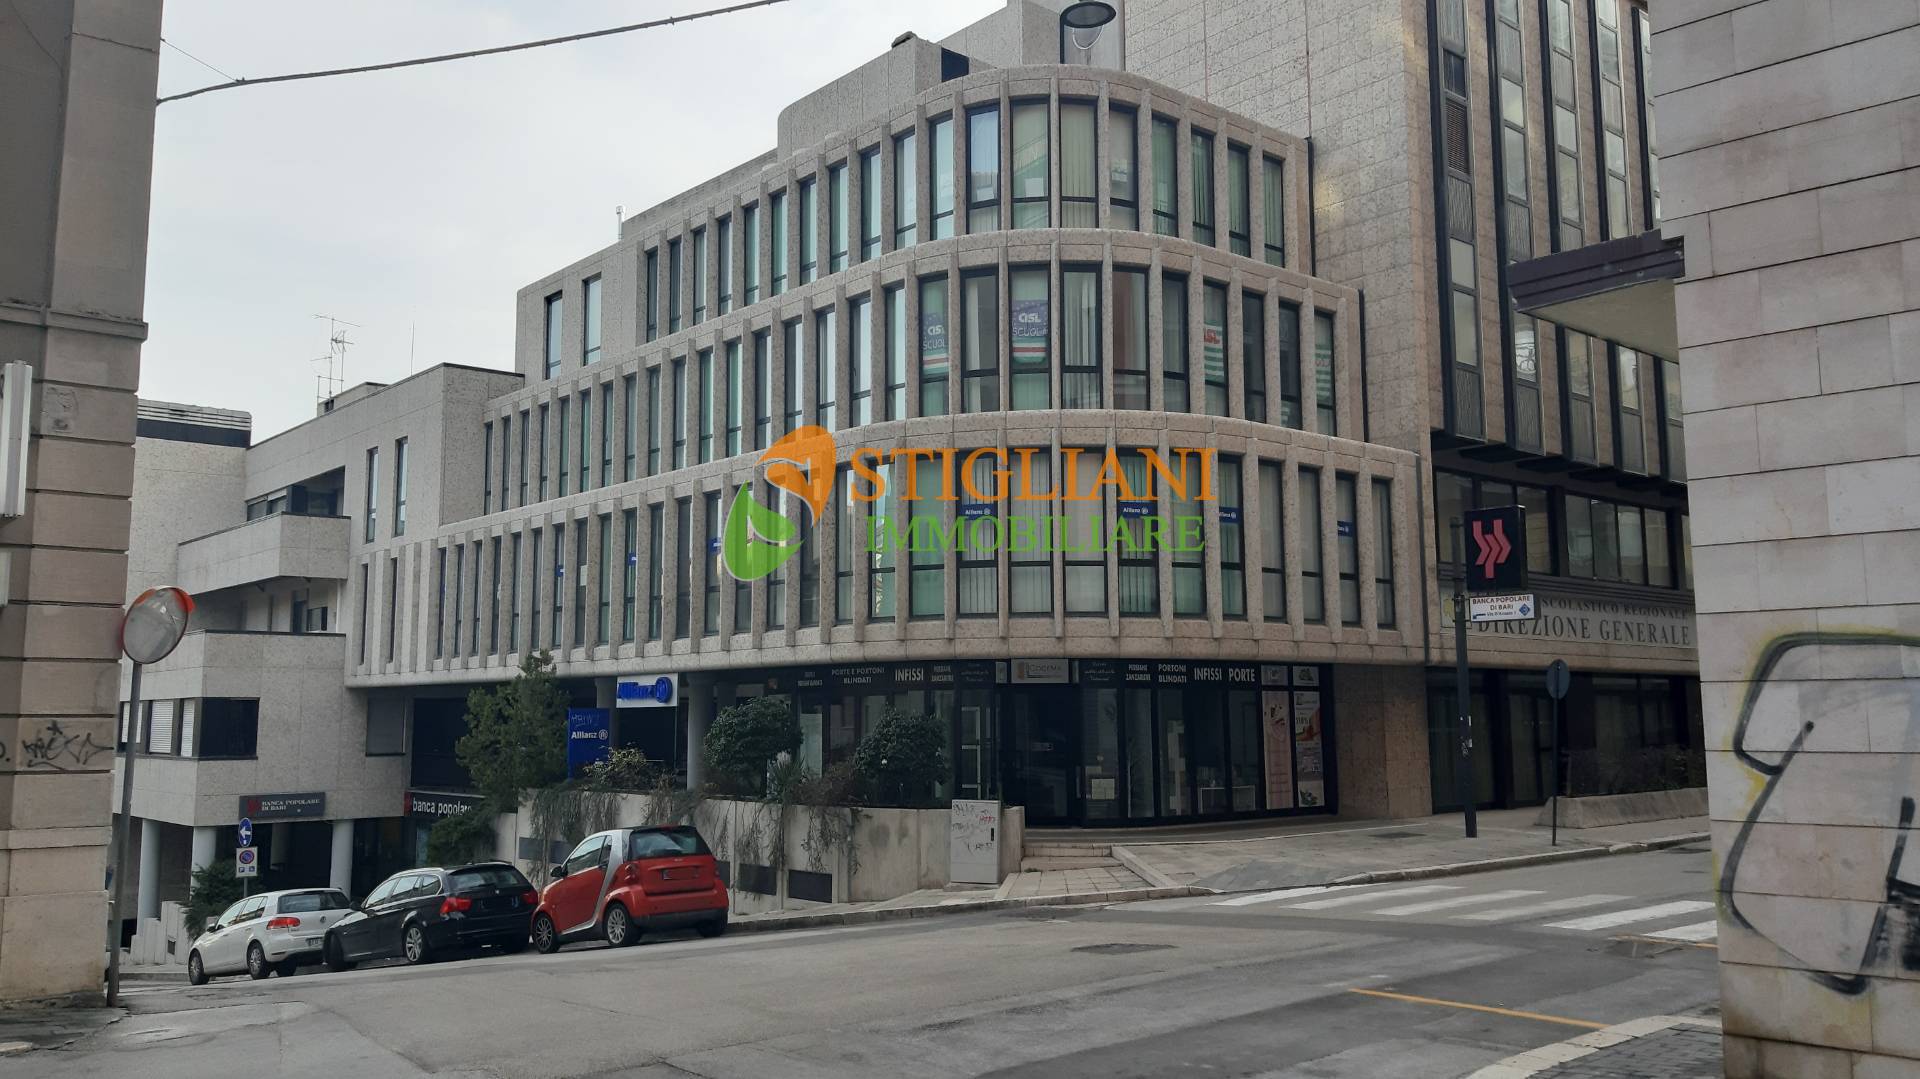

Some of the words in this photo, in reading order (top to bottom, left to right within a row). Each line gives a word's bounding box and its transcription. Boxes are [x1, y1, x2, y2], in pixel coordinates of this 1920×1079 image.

[1018, 313, 1041, 323] CISL
[1012, 327, 1049, 337] SCUOLA
[1472, 597, 1495, 605] BANCA
[1496, 595, 1531, 604] POPOLARE
[1541, 597, 1620, 614] SCOLASTICO
[1624, 601, 1689, 620] REGIONALE
[1478, 613, 1591, 640] DIREZIONE
[1600, 618, 1690, 646] GENERALE
[1158, 663, 1187, 673] PORTONI
[894, 667, 924, 682] INFISSI
[1158, 673, 1187, 683] BLINDATI
[1194, 667, 1223, 682] INFISSI
[1228, 667, 1256, 682] PORTE
[843, 676, 873, 685] BLINDATI
[571, 730, 598, 739] Allianz
[285, 798, 321, 806] POPOLARE
[412, 796, 436, 813] banca
